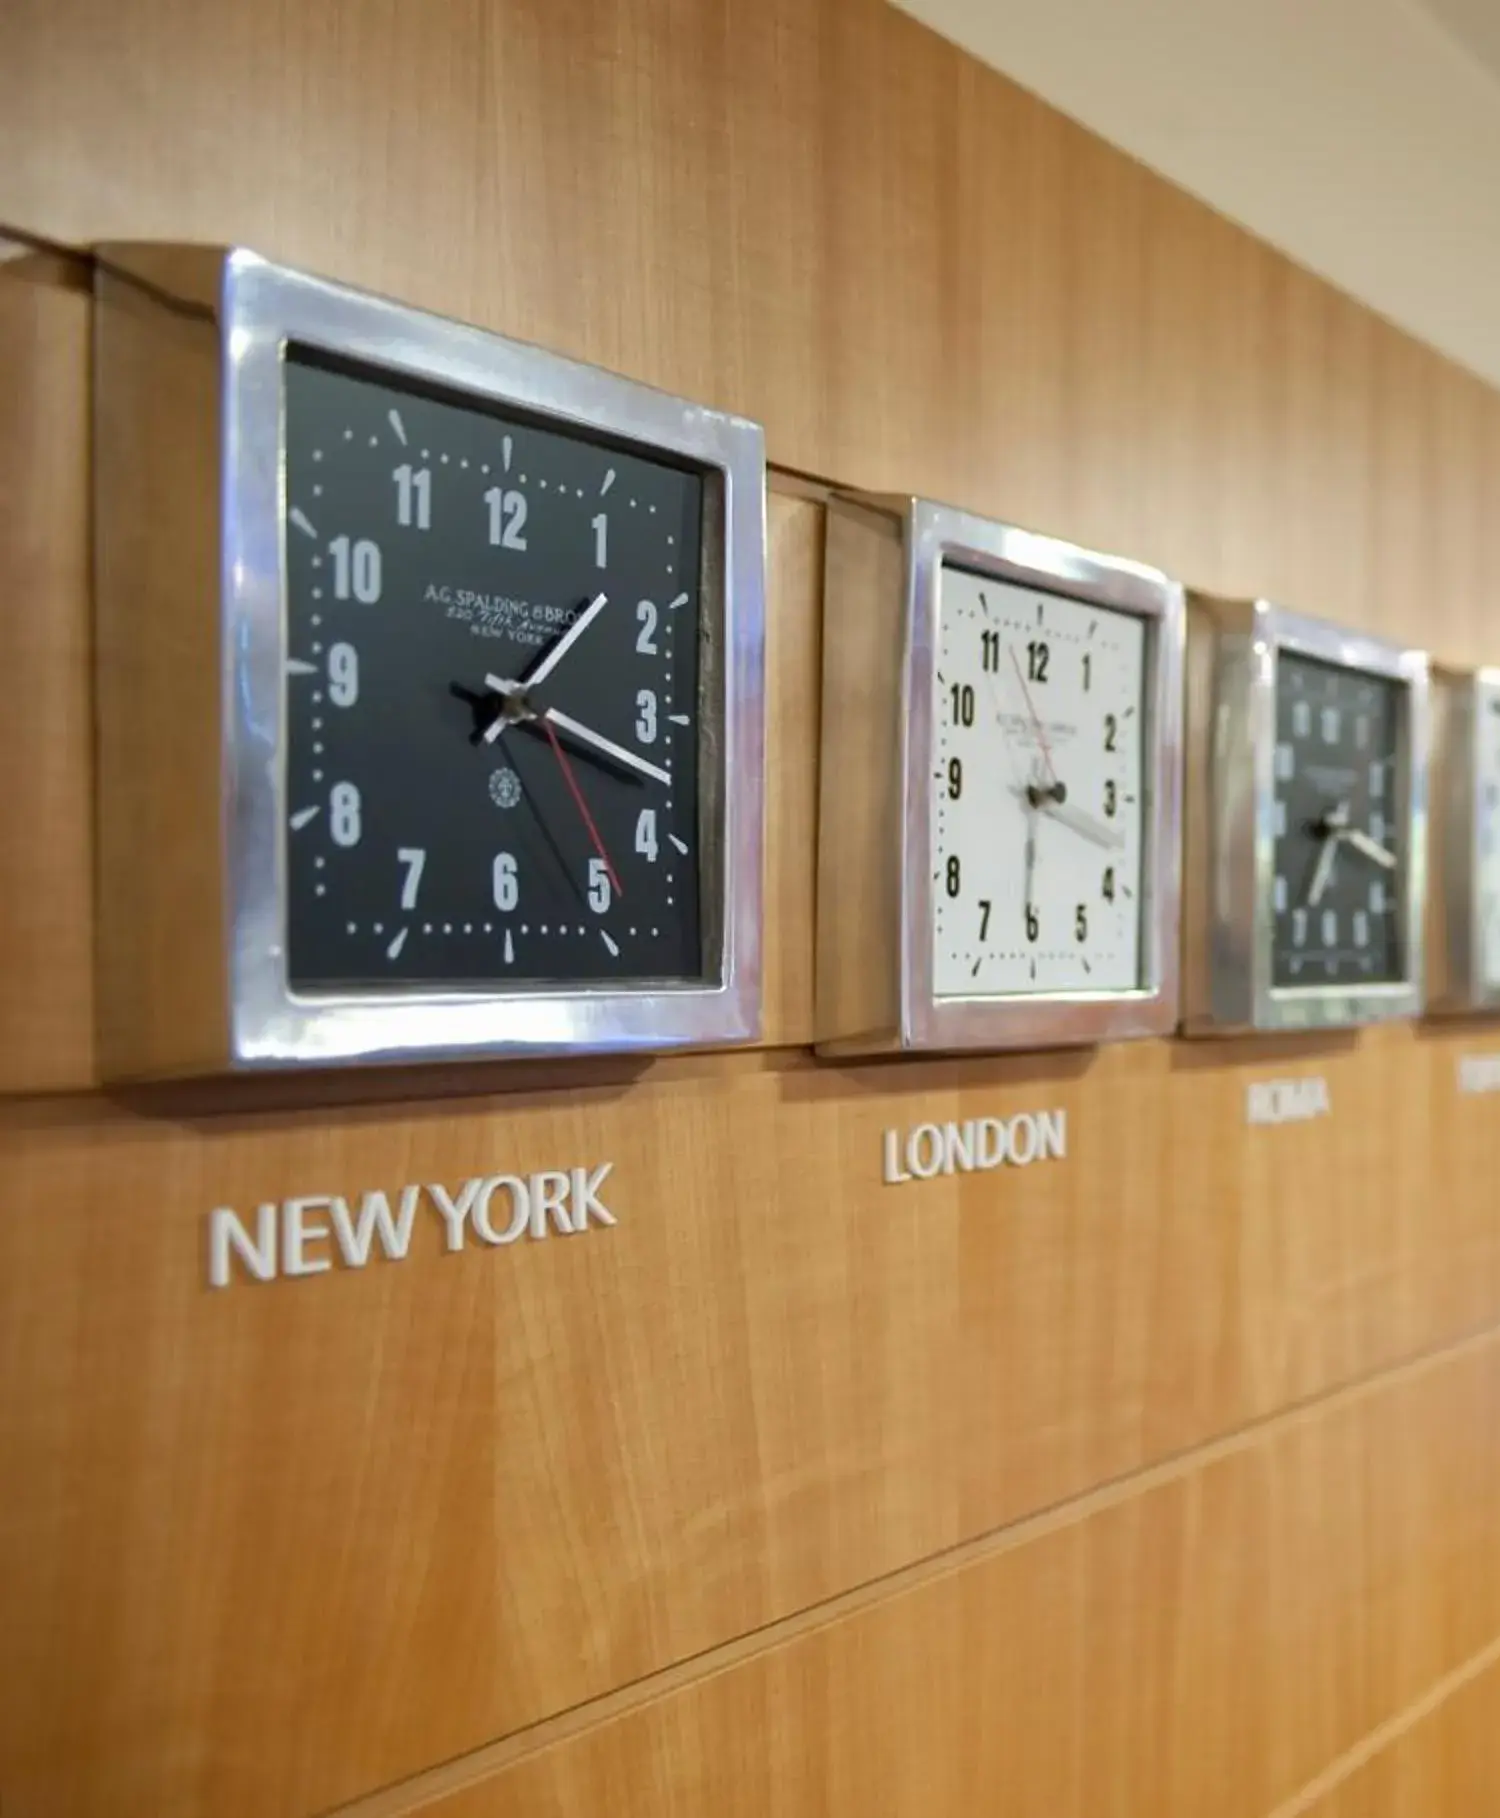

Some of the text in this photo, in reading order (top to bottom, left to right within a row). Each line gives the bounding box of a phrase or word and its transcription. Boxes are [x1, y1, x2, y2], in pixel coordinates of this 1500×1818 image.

[393, 464, 430, 529] 11
[485, 487, 527, 551] 12
[591, 513, 607, 569] 1
[330, 537, 380, 603] 10
[455, 588, 529, 619] SPALDING
[635, 599, 658, 655] 2
[470, 623, 545, 647] NEW YORK
[981, 630, 999, 672] 11
[330, 643, 357, 706] 9
[1027, 642, 1049, 682] 12
[635, 689, 657, 743] 3
[951, 683, 974, 727] 10
[1104, 715, 1116, 752] 2
[948, 757, 962, 800] 9
[1105, 779, 1116, 817] 3
[332, 783, 359, 845] 8
[635, 809, 658, 862] 4
[397, 848, 425, 909] 7
[494, 853, 518, 911] 6
[588, 859, 610, 914] 5
[946, 855, 960, 898] 8
[1102, 867, 1114, 901] 4
[978, 900, 991, 942] 7
[1025, 902, 1039, 942] 6
[1076, 904, 1086, 942] 5
[884, 1109, 1066, 1184] LONDON
[209, 1160, 618, 1286] NEW YORK
